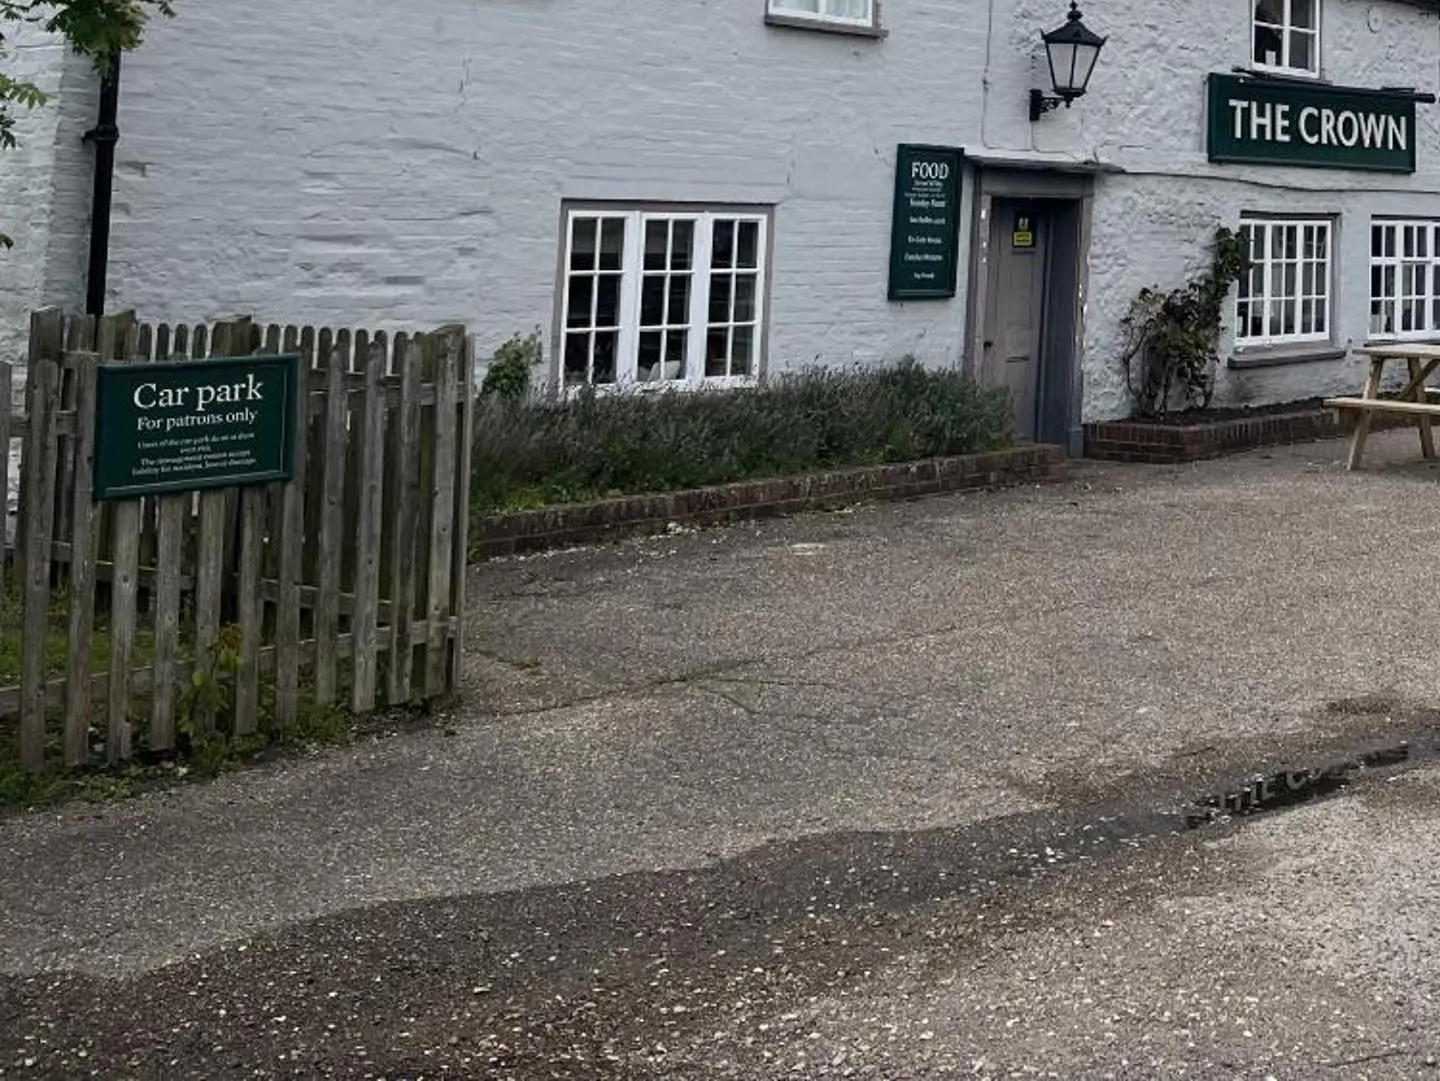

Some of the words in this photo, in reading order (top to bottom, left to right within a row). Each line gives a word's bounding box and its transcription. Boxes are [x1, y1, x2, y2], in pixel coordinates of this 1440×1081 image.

[1228, 99, 1291, 142] THE
[1299, 107, 1407, 150] CROWN
[911, 162, 950, 180] FOOD
[133, 382, 190, 410] Car
[195, 373, 264, 412] park
[137, 416, 164, 431] For
[165, 412, 224, 431] patrons
[225, 407, 258, 425] only
